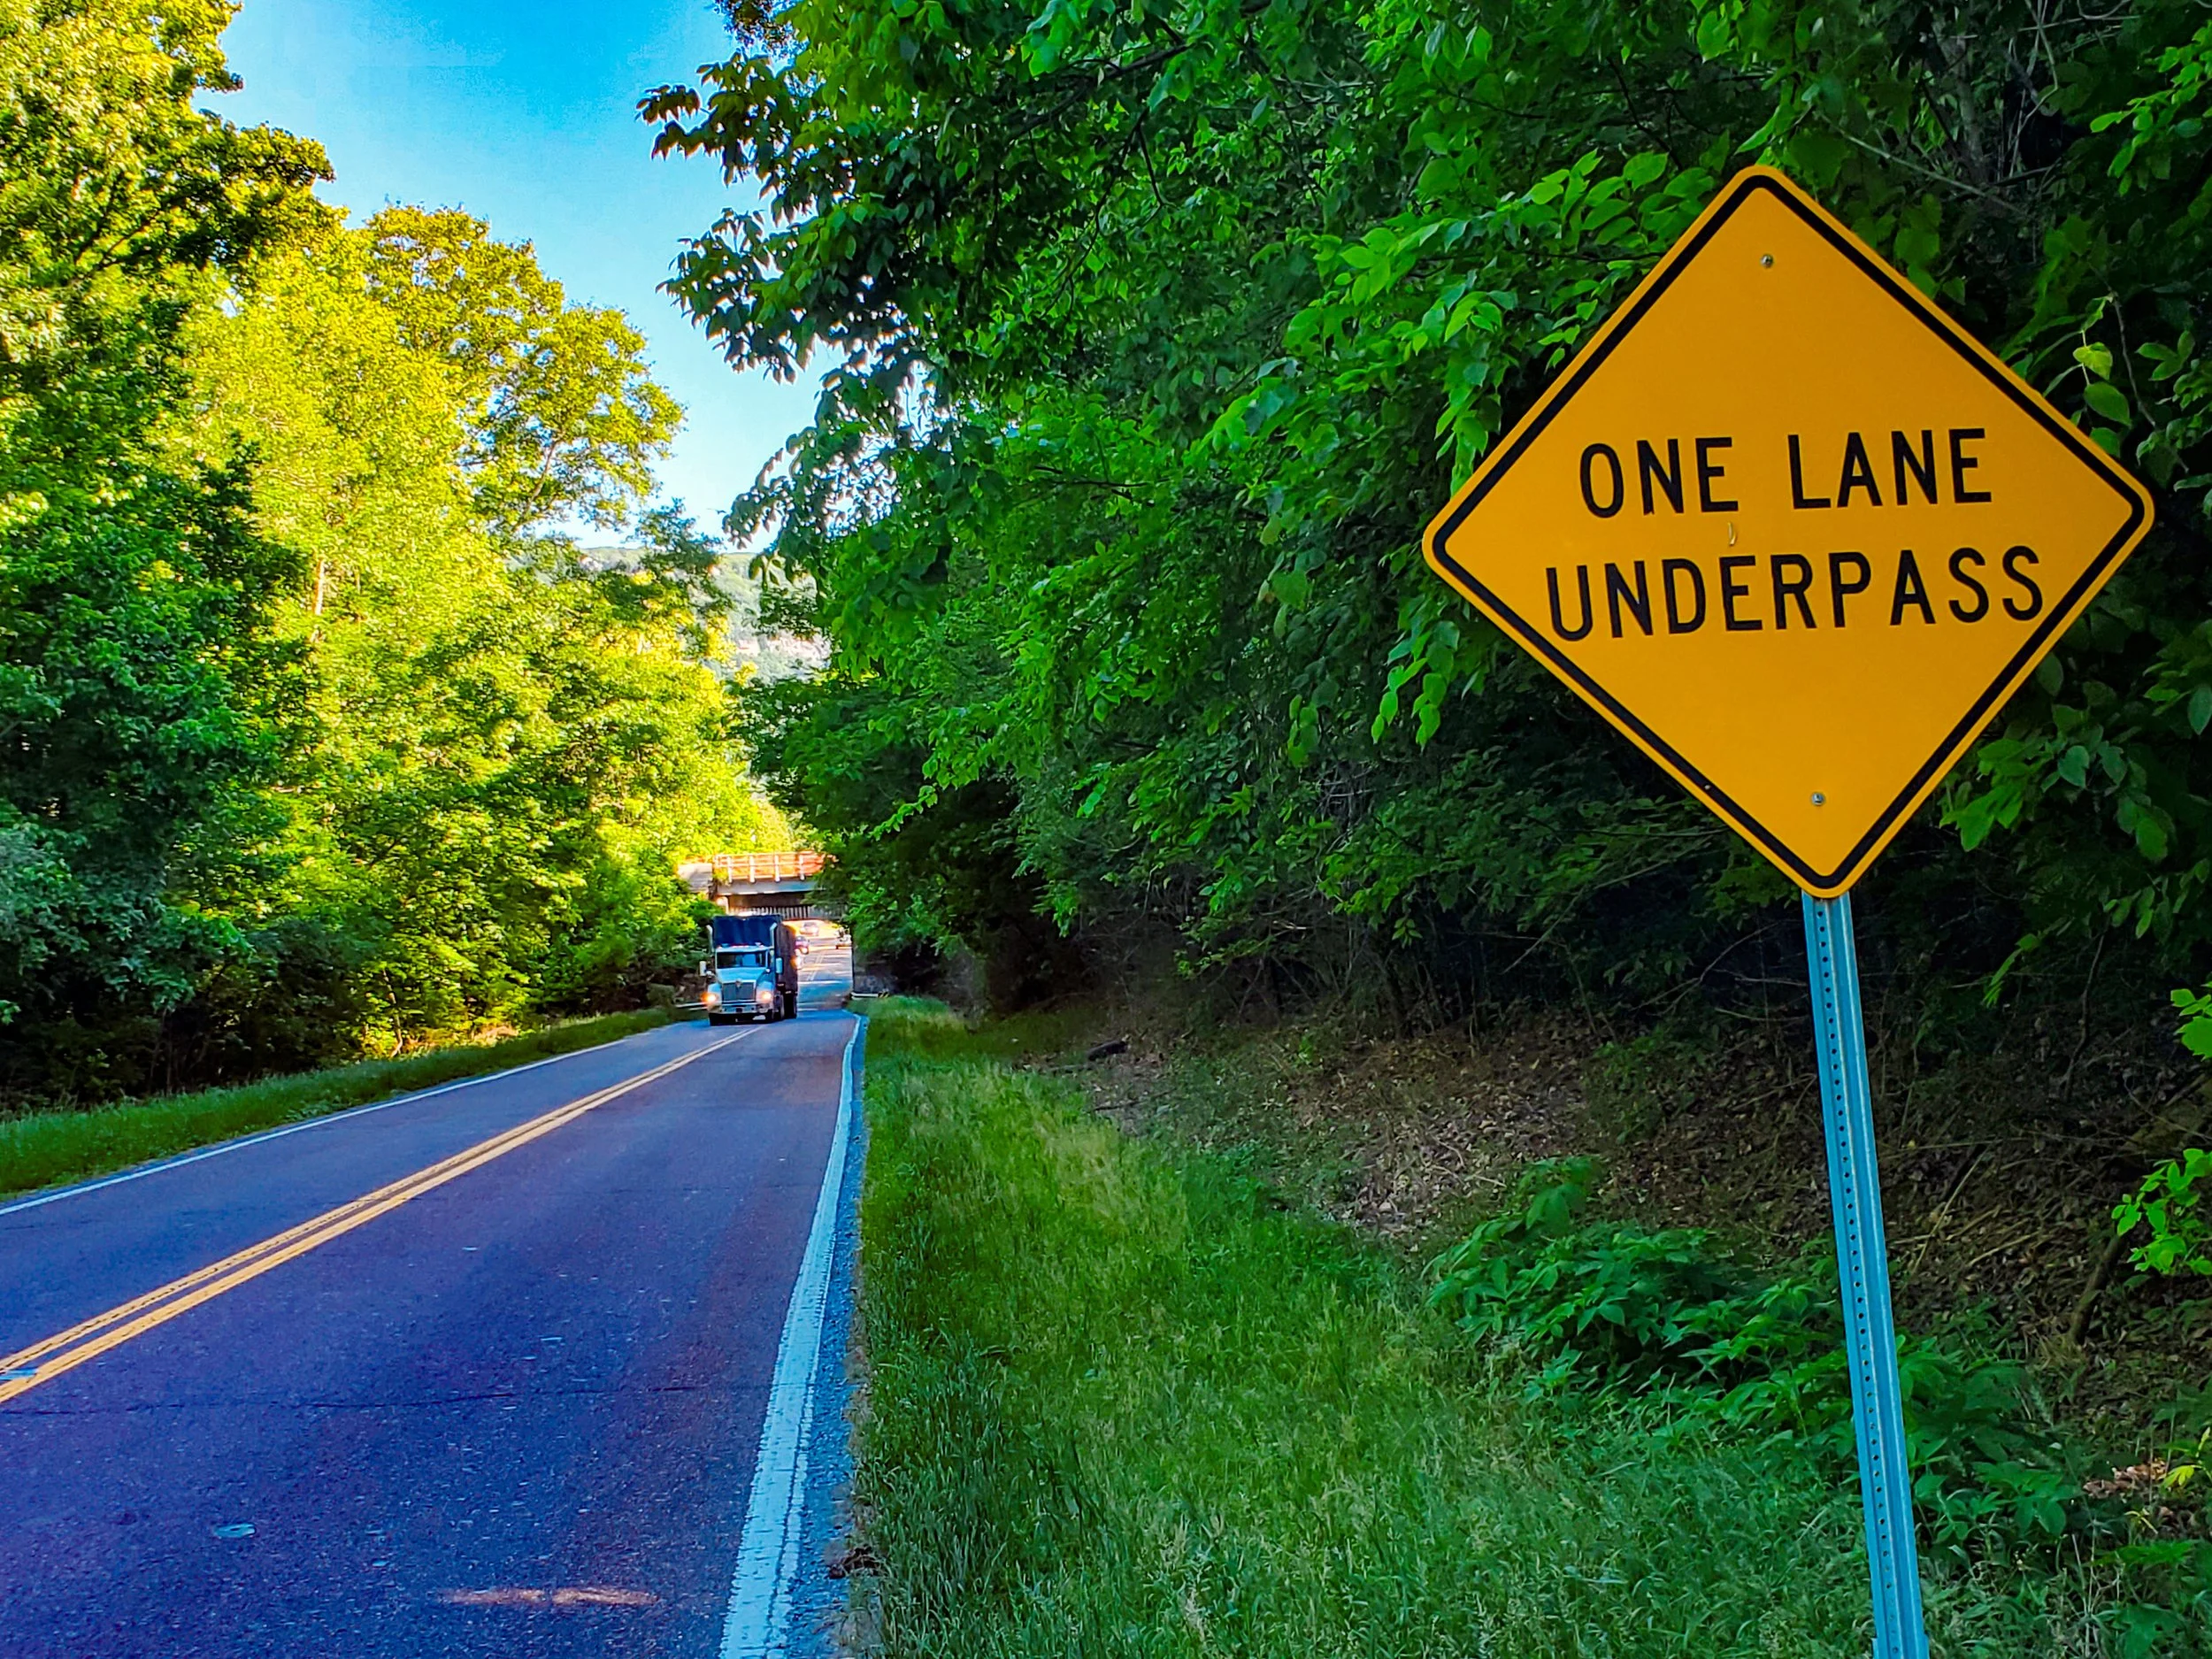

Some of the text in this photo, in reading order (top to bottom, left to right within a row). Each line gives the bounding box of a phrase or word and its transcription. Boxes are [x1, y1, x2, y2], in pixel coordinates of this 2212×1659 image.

[1579, 427, 1992, 518] ONE LANE
[1546, 545, 2043, 641] UNDERPASS
